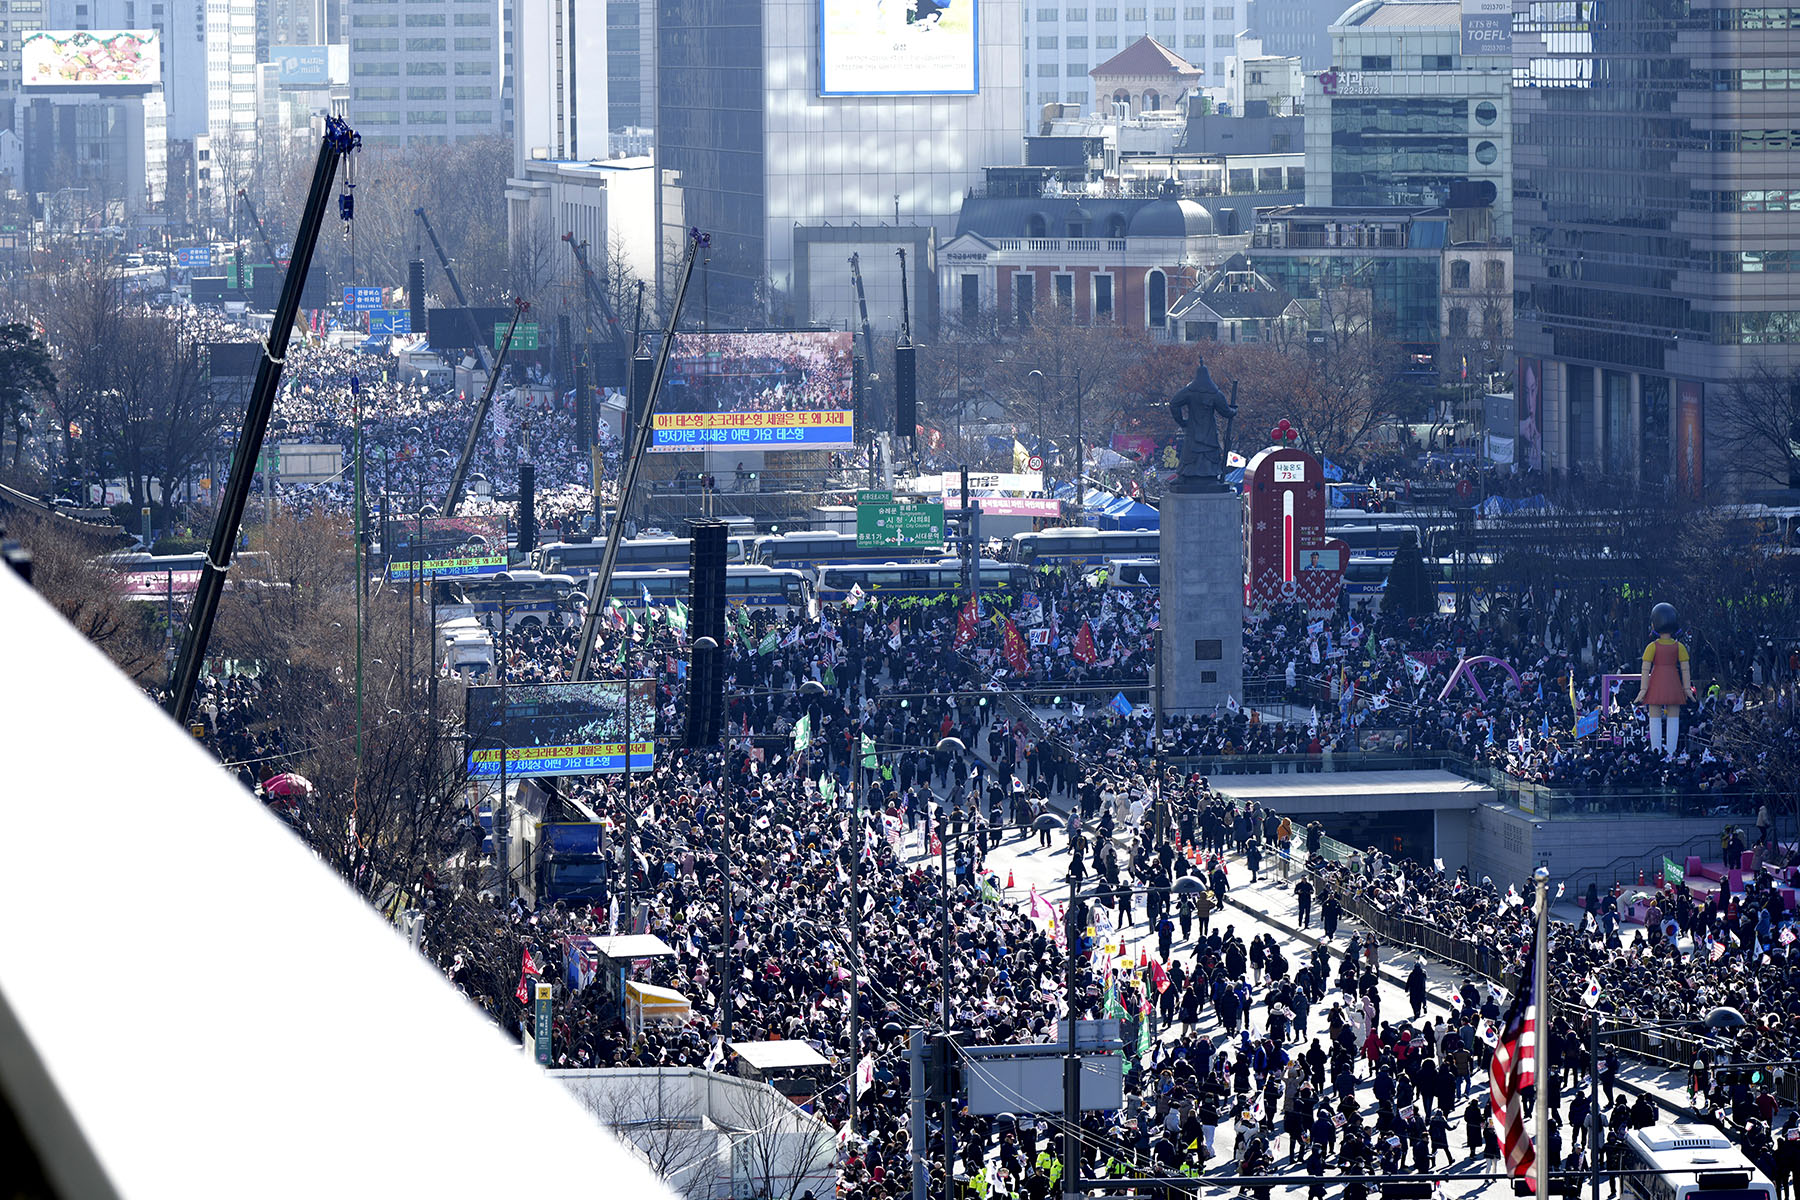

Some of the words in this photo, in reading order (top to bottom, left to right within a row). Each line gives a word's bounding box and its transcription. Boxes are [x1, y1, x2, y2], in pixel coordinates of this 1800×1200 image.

[1468, 30, 1506, 40] TOEFL
[1320, 71, 1337, 94] 연
[1338, 71, 1364, 87] 치과
[658, 415, 672, 427] 아!
[676, 415, 703, 426] 테스형
[708, 414, 763, 426] 소크라테스형
[766, 413, 794, 425] 세월은
[798, 413, 807, 424] 또
[811, 413, 821, 424] 왜
[825, 412, 844, 424] 저래
[658, 429, 695, 442] 먼저가본
[700, 429, 727, 442] 저세상
[731, 429, 750, 441] 어떤
[754, 428, 772, 441] 가요
[776, 428, 804, 440] 테스형
[969, 475, 999, 487] 다음은
[524, 747, 573, 758] 소크라테스형
[577, 745, 602, 756] 세월은
[605, 745, 613, 754] 또
[630, 743, 646, 753] 저래
[544, 758, 562, 769] 어떤
[565, 758, 581, 768] 가요
[585, 757, 610, 766] 테스형
[542, 1001, 547, 1009] 2
